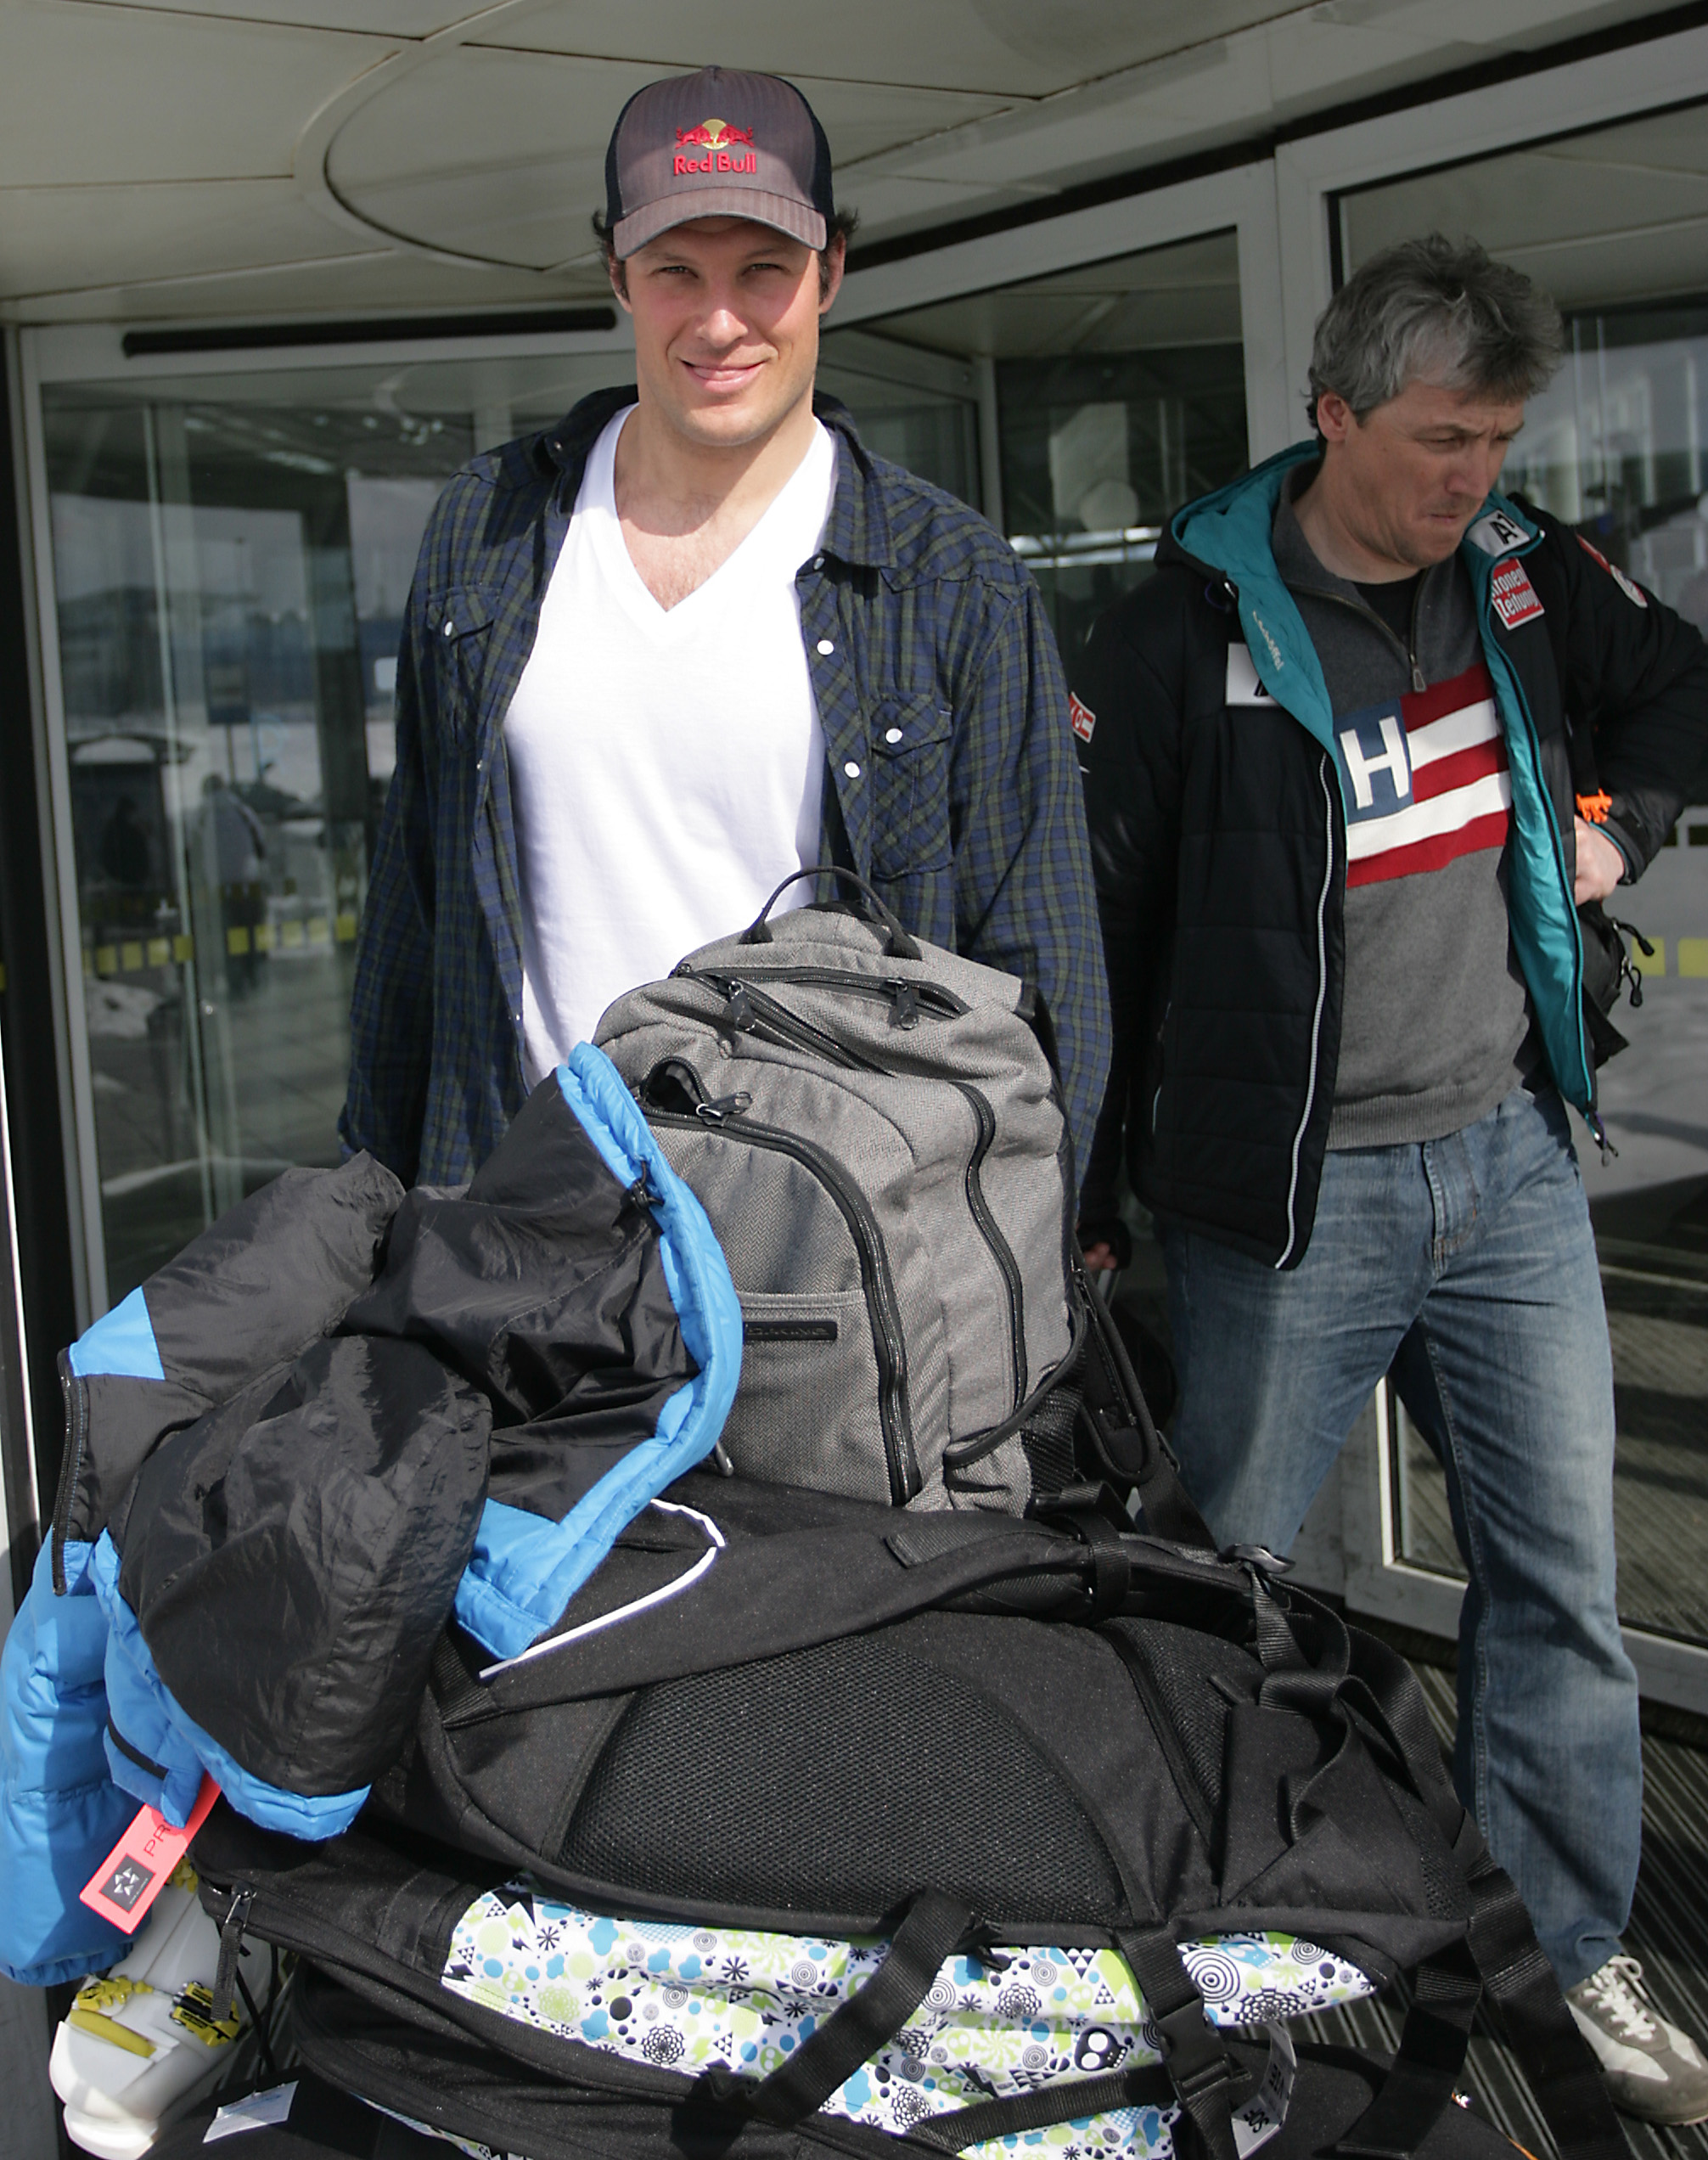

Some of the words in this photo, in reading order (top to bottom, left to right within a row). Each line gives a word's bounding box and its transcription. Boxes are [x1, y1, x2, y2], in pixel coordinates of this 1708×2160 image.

[673, 150, 714, 176] Red
[716, 152, 757, 174] Bull
[1489, 513, 1519, 545] A1
[1496, 588, 1540, 618] Zeitung
[143, 1820, 173, 1857] PR
